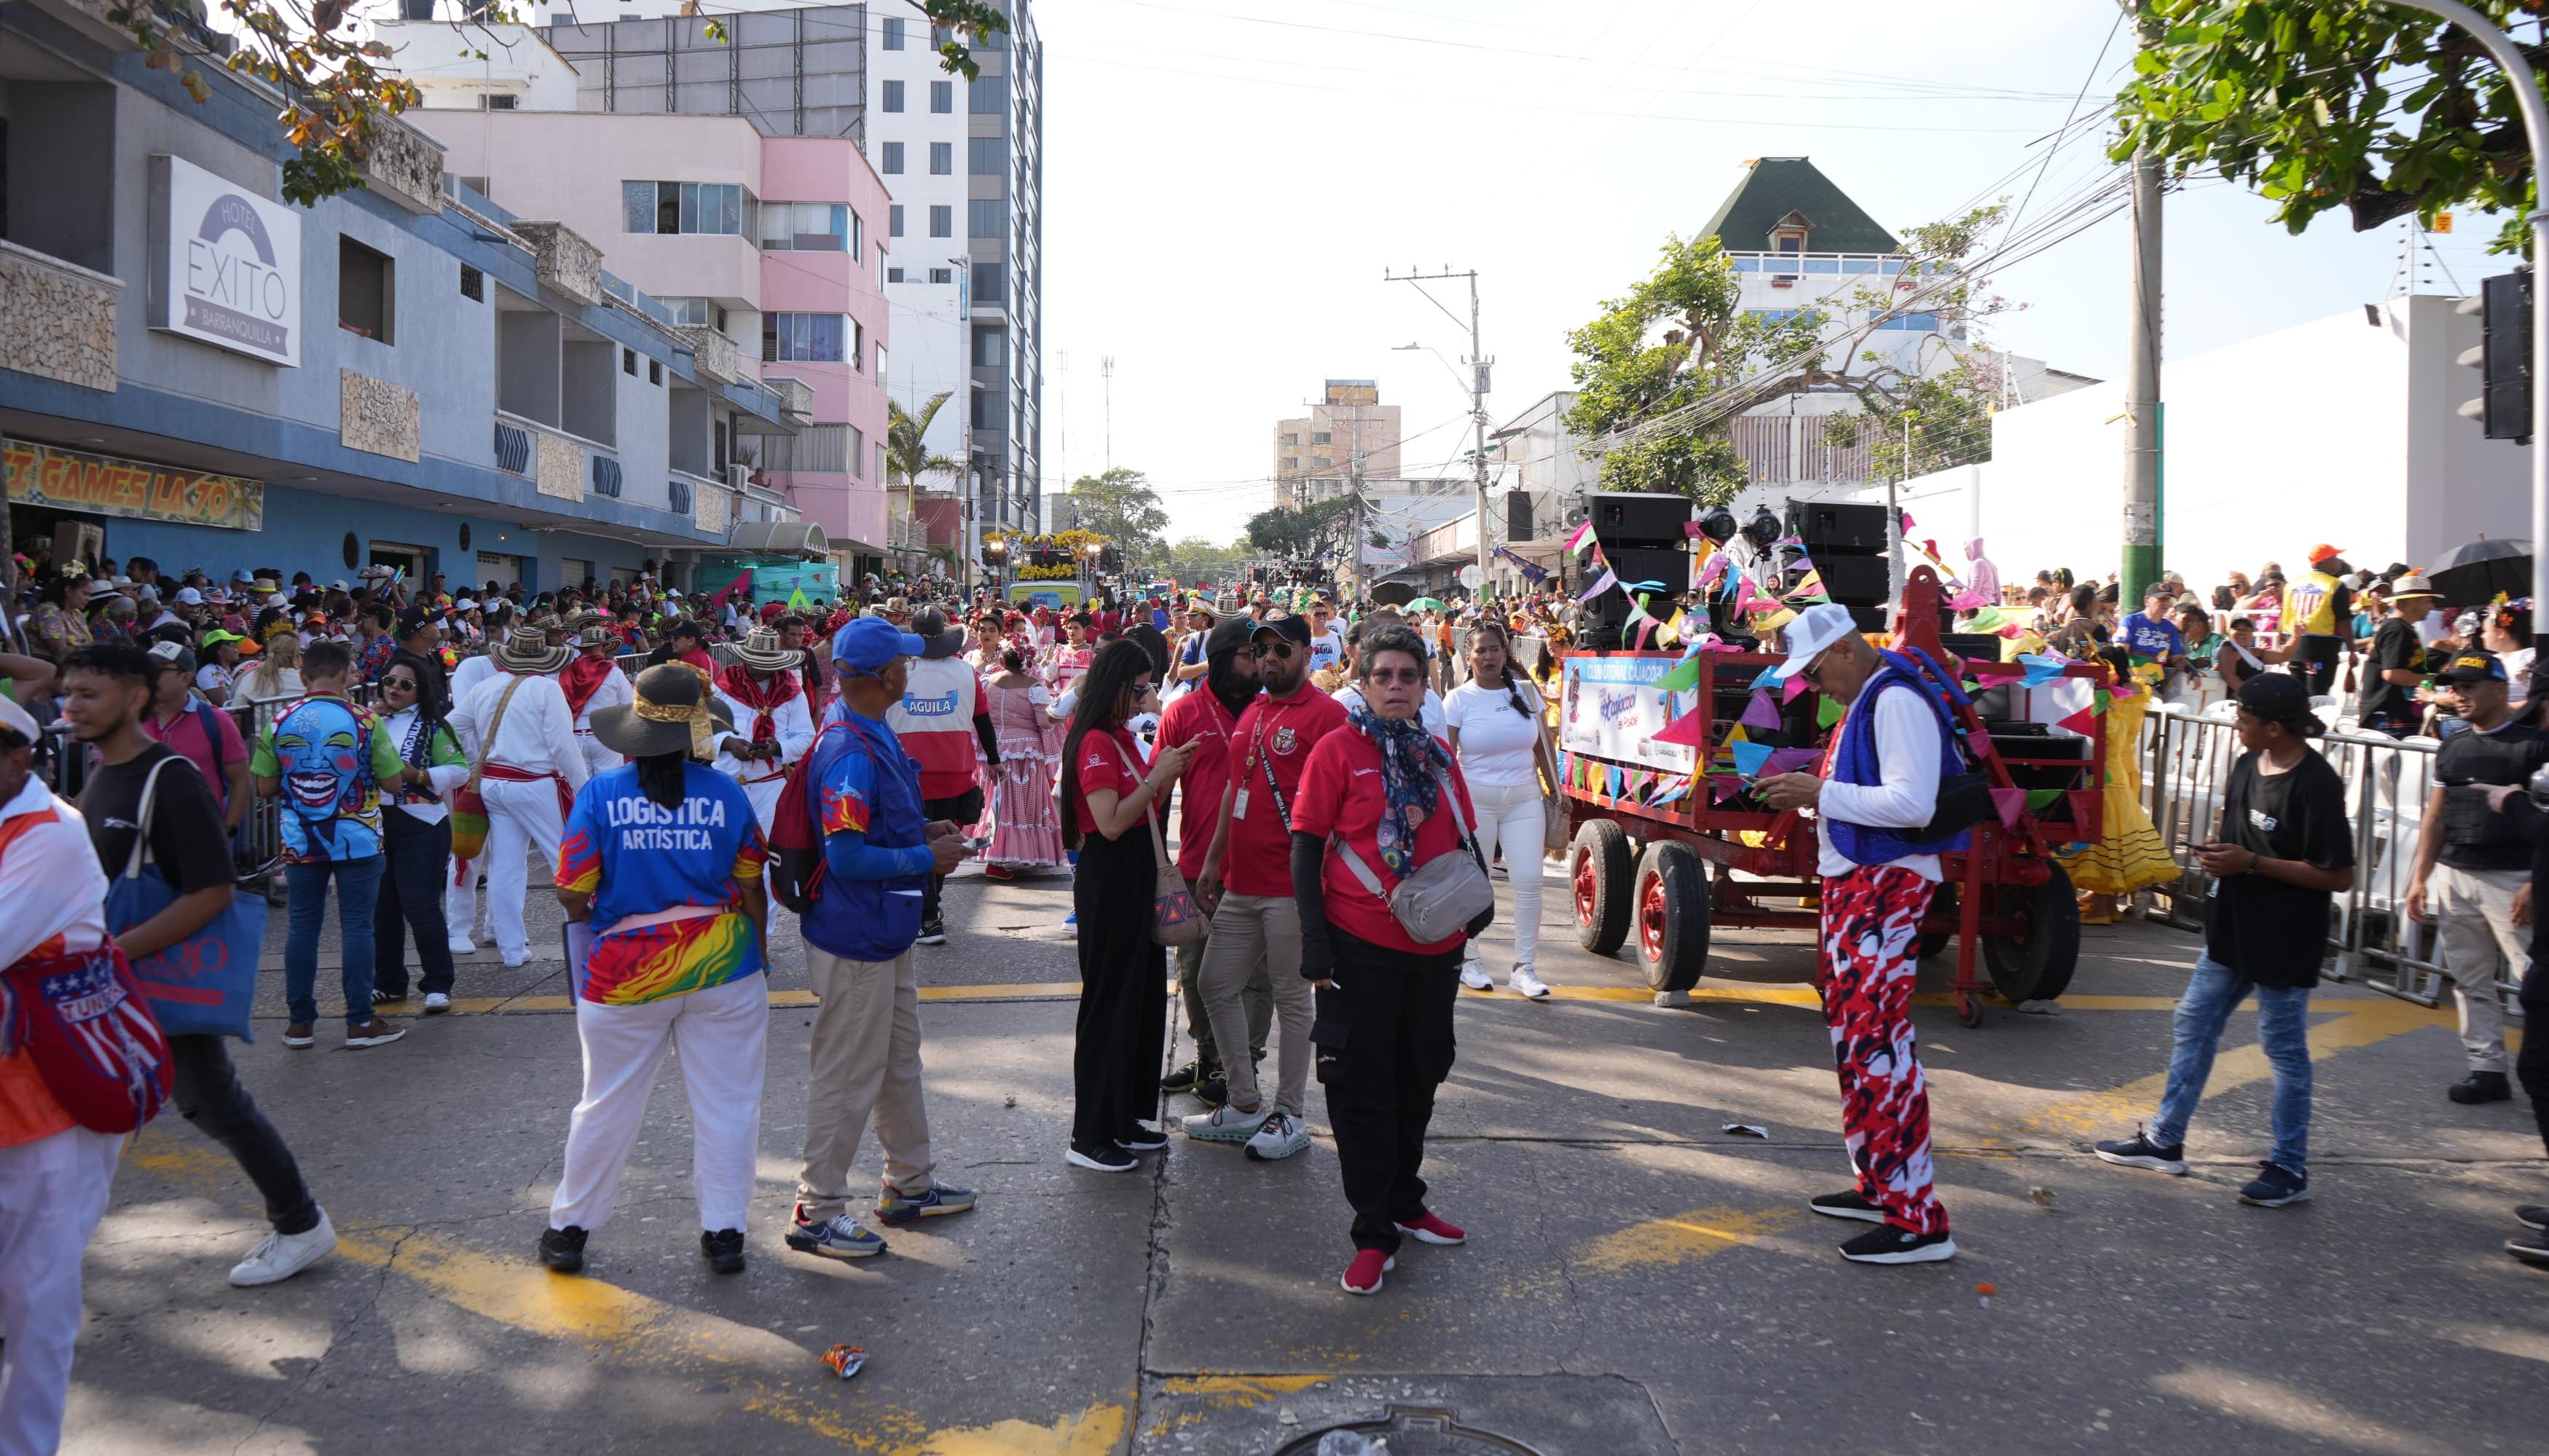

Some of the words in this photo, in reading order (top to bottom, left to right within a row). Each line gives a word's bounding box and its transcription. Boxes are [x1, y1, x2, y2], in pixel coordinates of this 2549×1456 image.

[221, 202, 255, 235] HOTEL
[188, 239, 286, 320] EXITO
[202, 308, 272, 342] BARRANQUILLA
[40, 457, 152, 509] GAMES
[150, 473, 186, 513] LA
[190, 482, 230, 519] 70
[1587, 664, 1603, 680] CLUB
[1628, 664, 1663, 682] CAJACOPI
[909, 700, 951, 713] AGUILA
[401, 716, 424, 763] ANQUILLA
[1262, 760, 1276, 786] FOREVER
[1273, 791, 1287, 811] YOUNG
[623, 825, 713, 850] ARTÍSTICA
